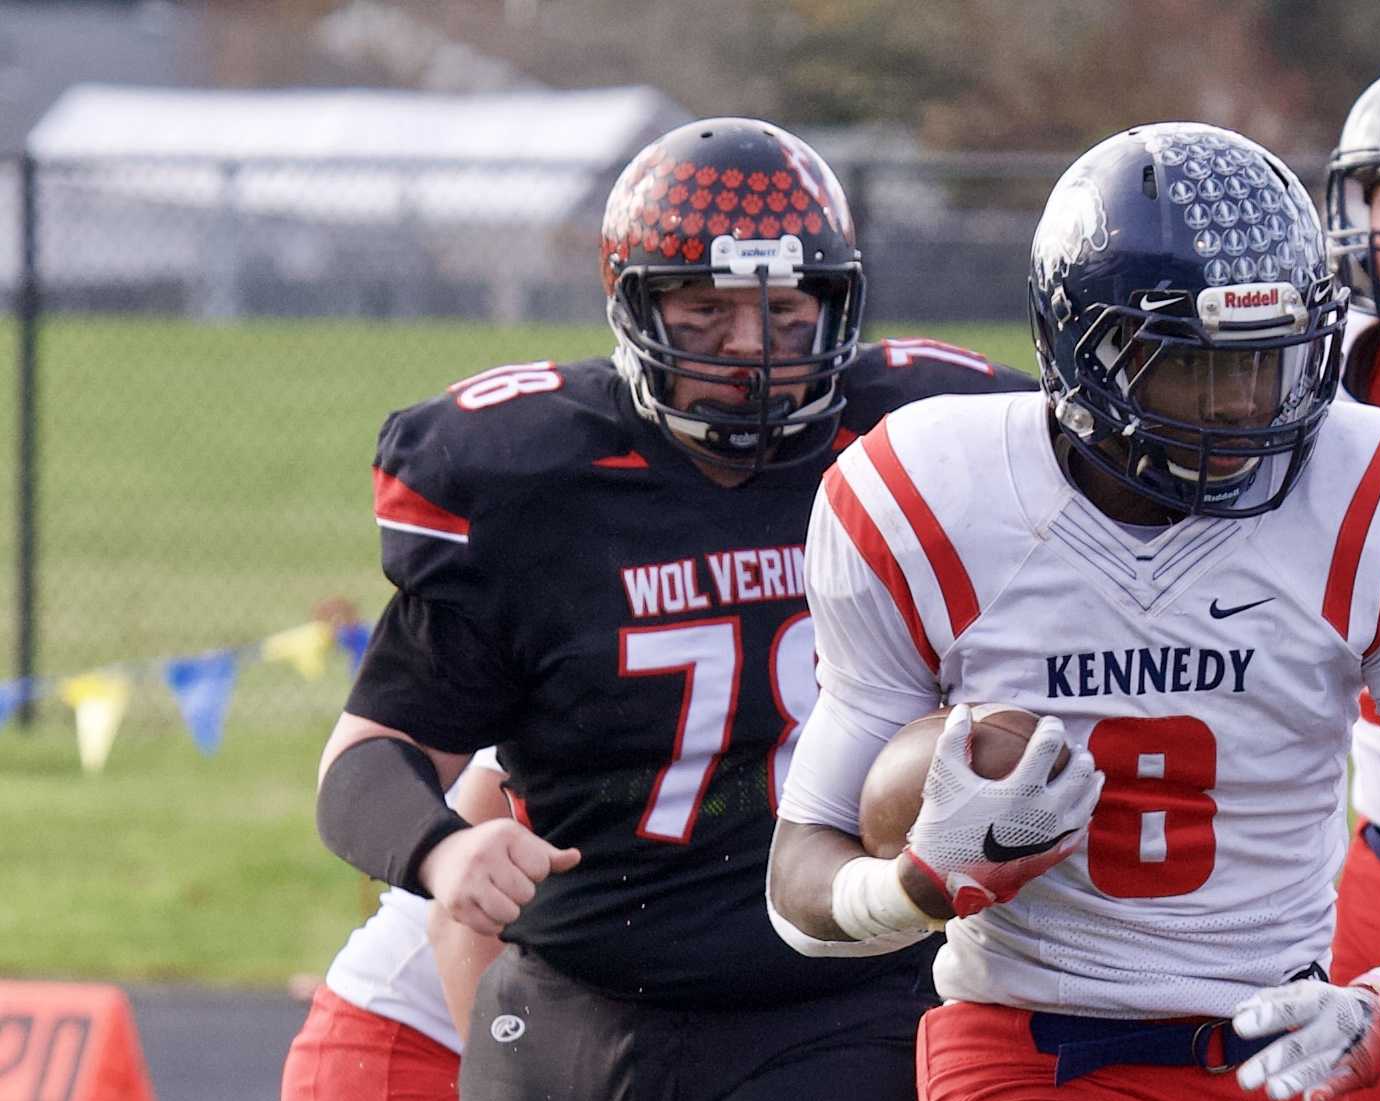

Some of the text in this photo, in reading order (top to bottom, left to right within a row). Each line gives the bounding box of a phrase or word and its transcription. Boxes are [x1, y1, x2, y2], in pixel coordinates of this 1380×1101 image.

[1224, 287, 1279, 309] Riddell
[1046, 646, 1256, 698] KENNEDY
[1087, 715, 1217, 898] 8
